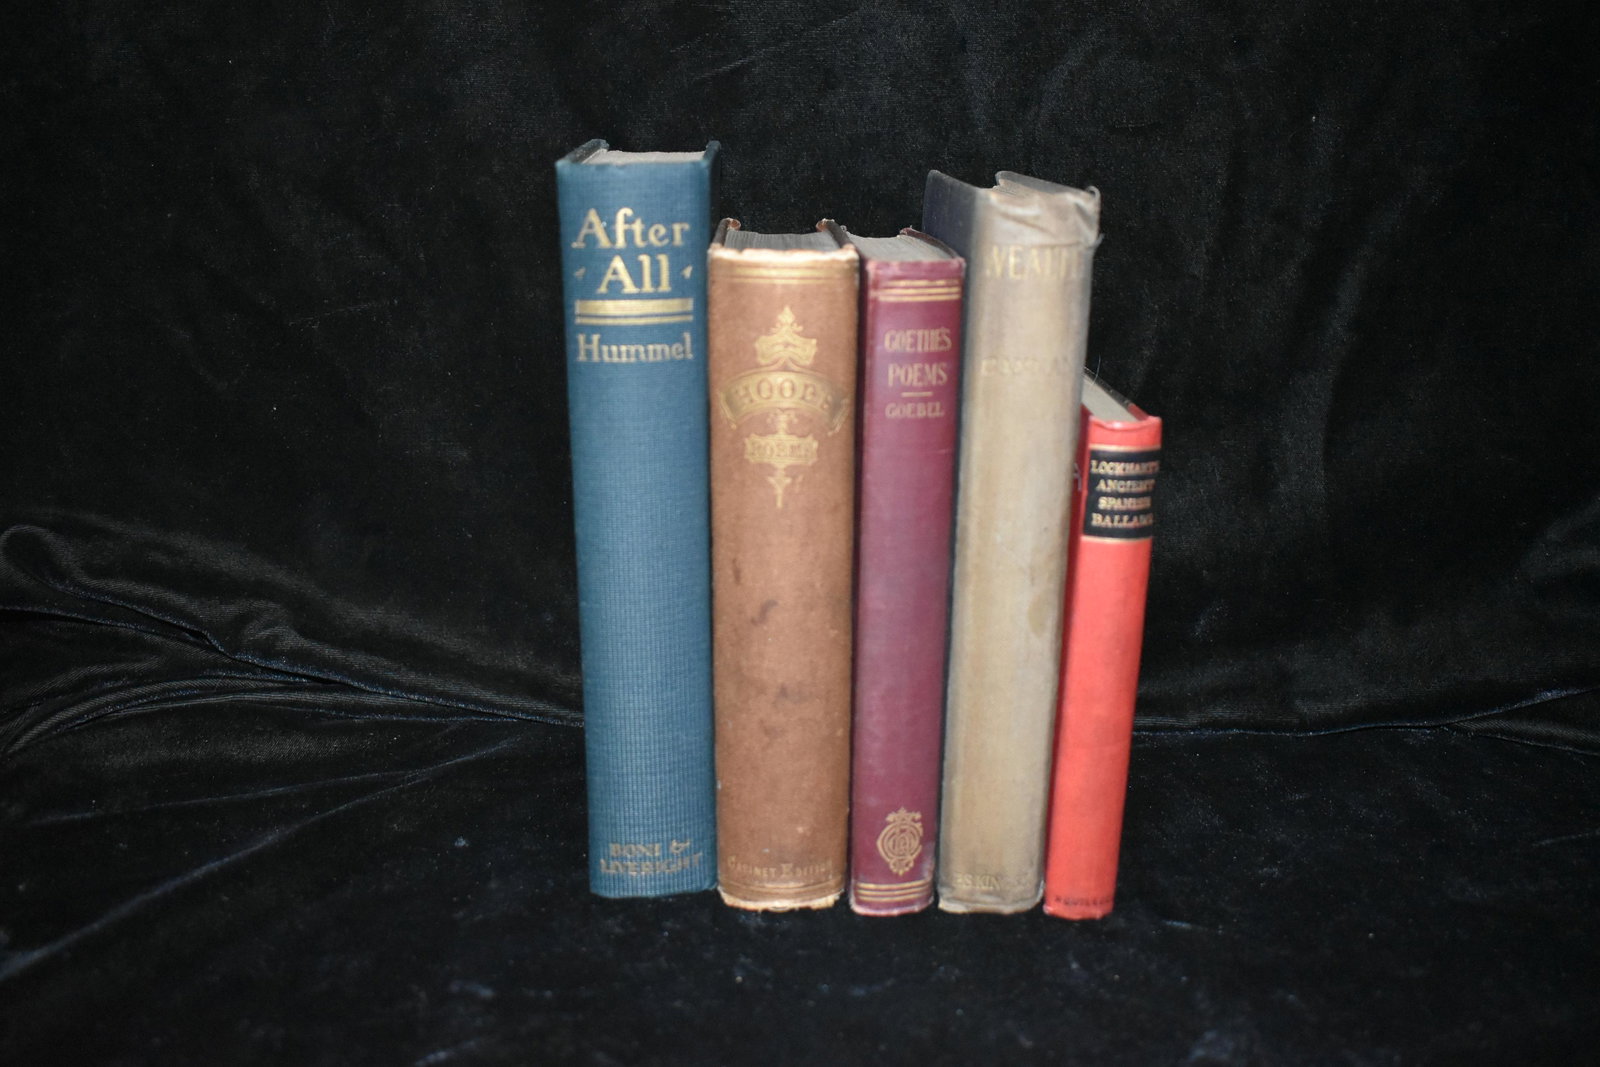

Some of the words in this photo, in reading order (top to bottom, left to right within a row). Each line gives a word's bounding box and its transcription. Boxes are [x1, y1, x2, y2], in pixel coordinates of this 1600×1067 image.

[571, 207, 690, 249] After
[596, 253, 672, 294] All
[576, 332, 693, 363] Hummel
[888, 362, 948, 387] POEMS
